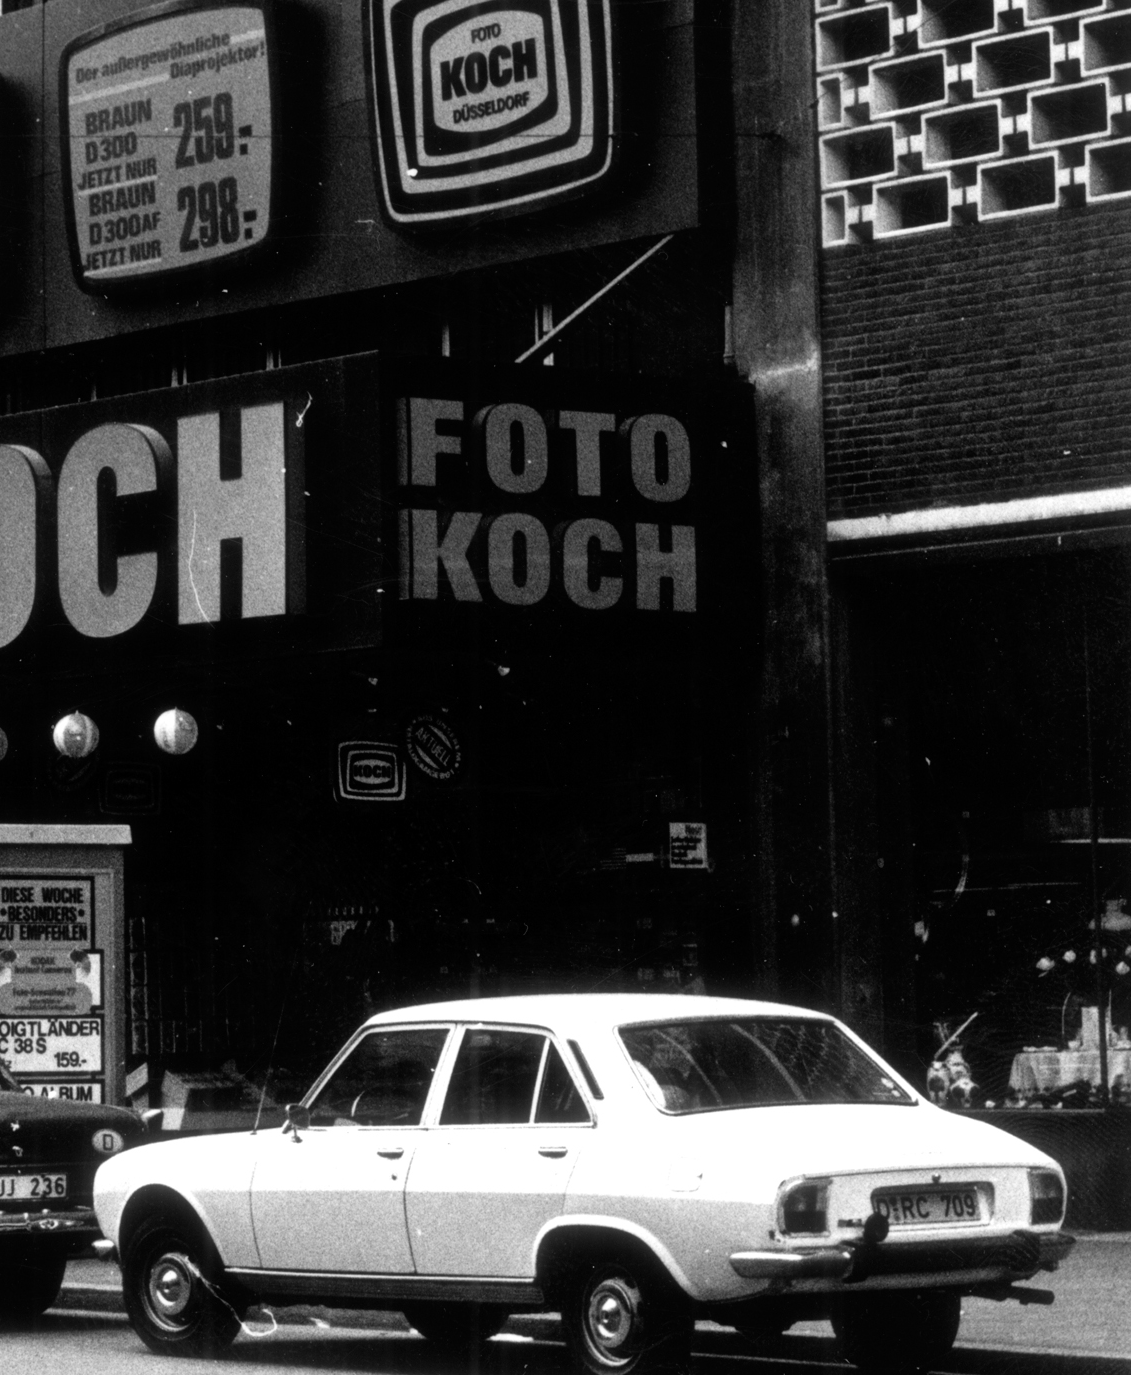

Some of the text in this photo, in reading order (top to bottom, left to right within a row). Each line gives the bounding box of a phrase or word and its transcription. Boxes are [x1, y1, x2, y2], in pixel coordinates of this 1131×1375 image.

[470, 22, 502, 44] FOTO
[75, 33, 231, 84] Der außergewöhnliche
[170, 41, 266, 80] Diaprojektor!
[439, 37, 538, 102] KOCH
[85, 98, 153, 136] BRAUN
[452, 91, 531, 124] DÜSSELDORF
[77, 157, 158, 192] JETZT NUR
[88, 180, 156, 217] BRAUN
[83, 239, 162, 271] JETZT NUR
[405, 397, 692, 503] FOTO
[406, 509, 697, 613] KOCH
[1, 887, 84, 904] DIESE WOCHE
[7, 906, 78, 922] BESONDERS
[19, 924, 88, 941] EMPFEHLEN
[54, 1051, 87, 1068] 159.-
[40, 1086, 93, 1101] ABUM
[102, 1133, 114, 1151] D
[30, 1176, 65, 1197] 236
[940, 1193, 976, 1218] 709
